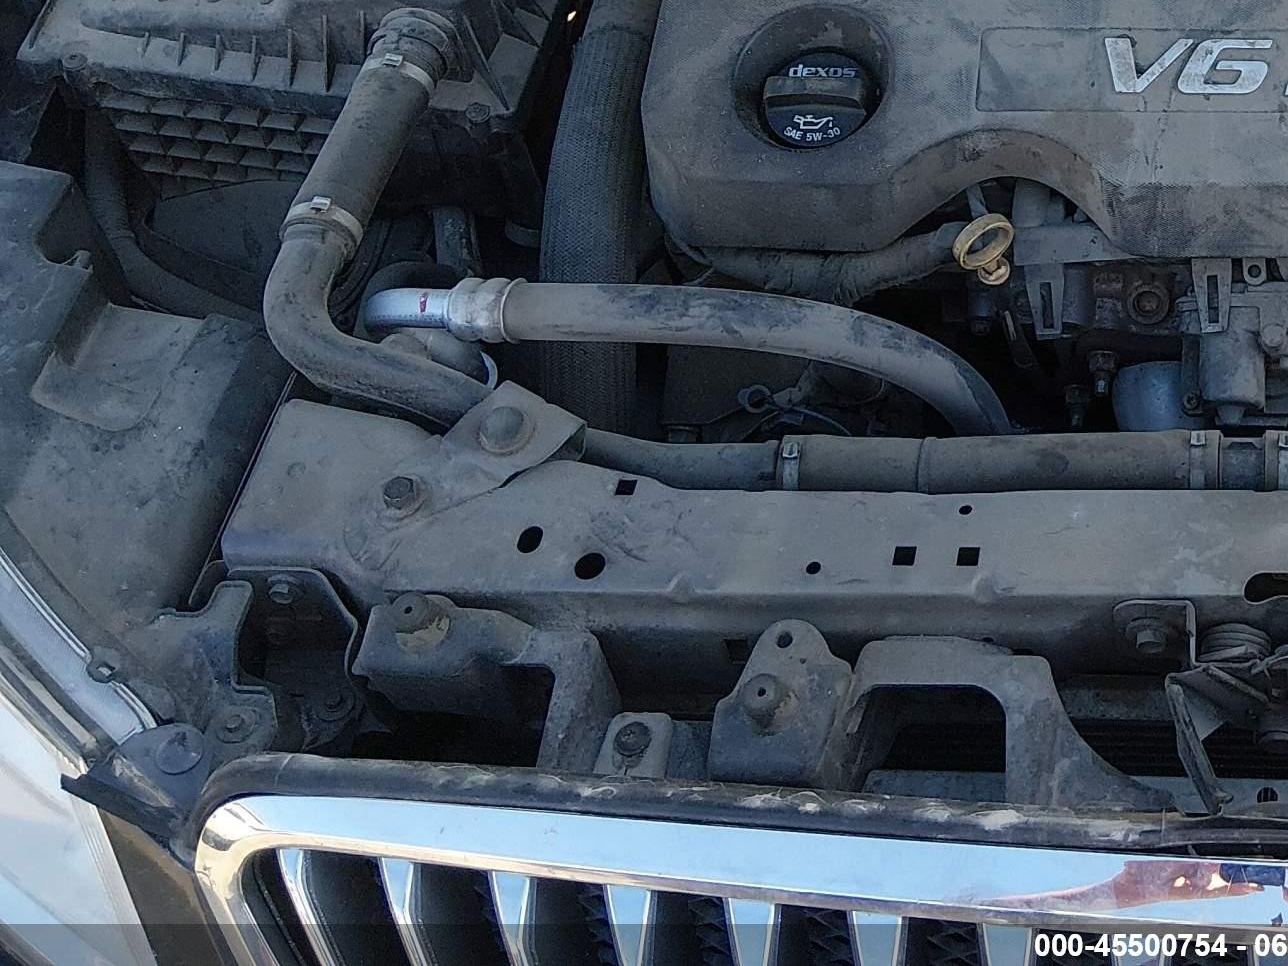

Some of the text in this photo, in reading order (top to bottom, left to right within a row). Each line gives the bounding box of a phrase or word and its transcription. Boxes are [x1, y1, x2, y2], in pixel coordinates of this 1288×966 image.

[788, 64, 859, 78] dexos
[1104, 37, 1274, 95] V6
[783, 126, 841, 142] SAE 5W-30
